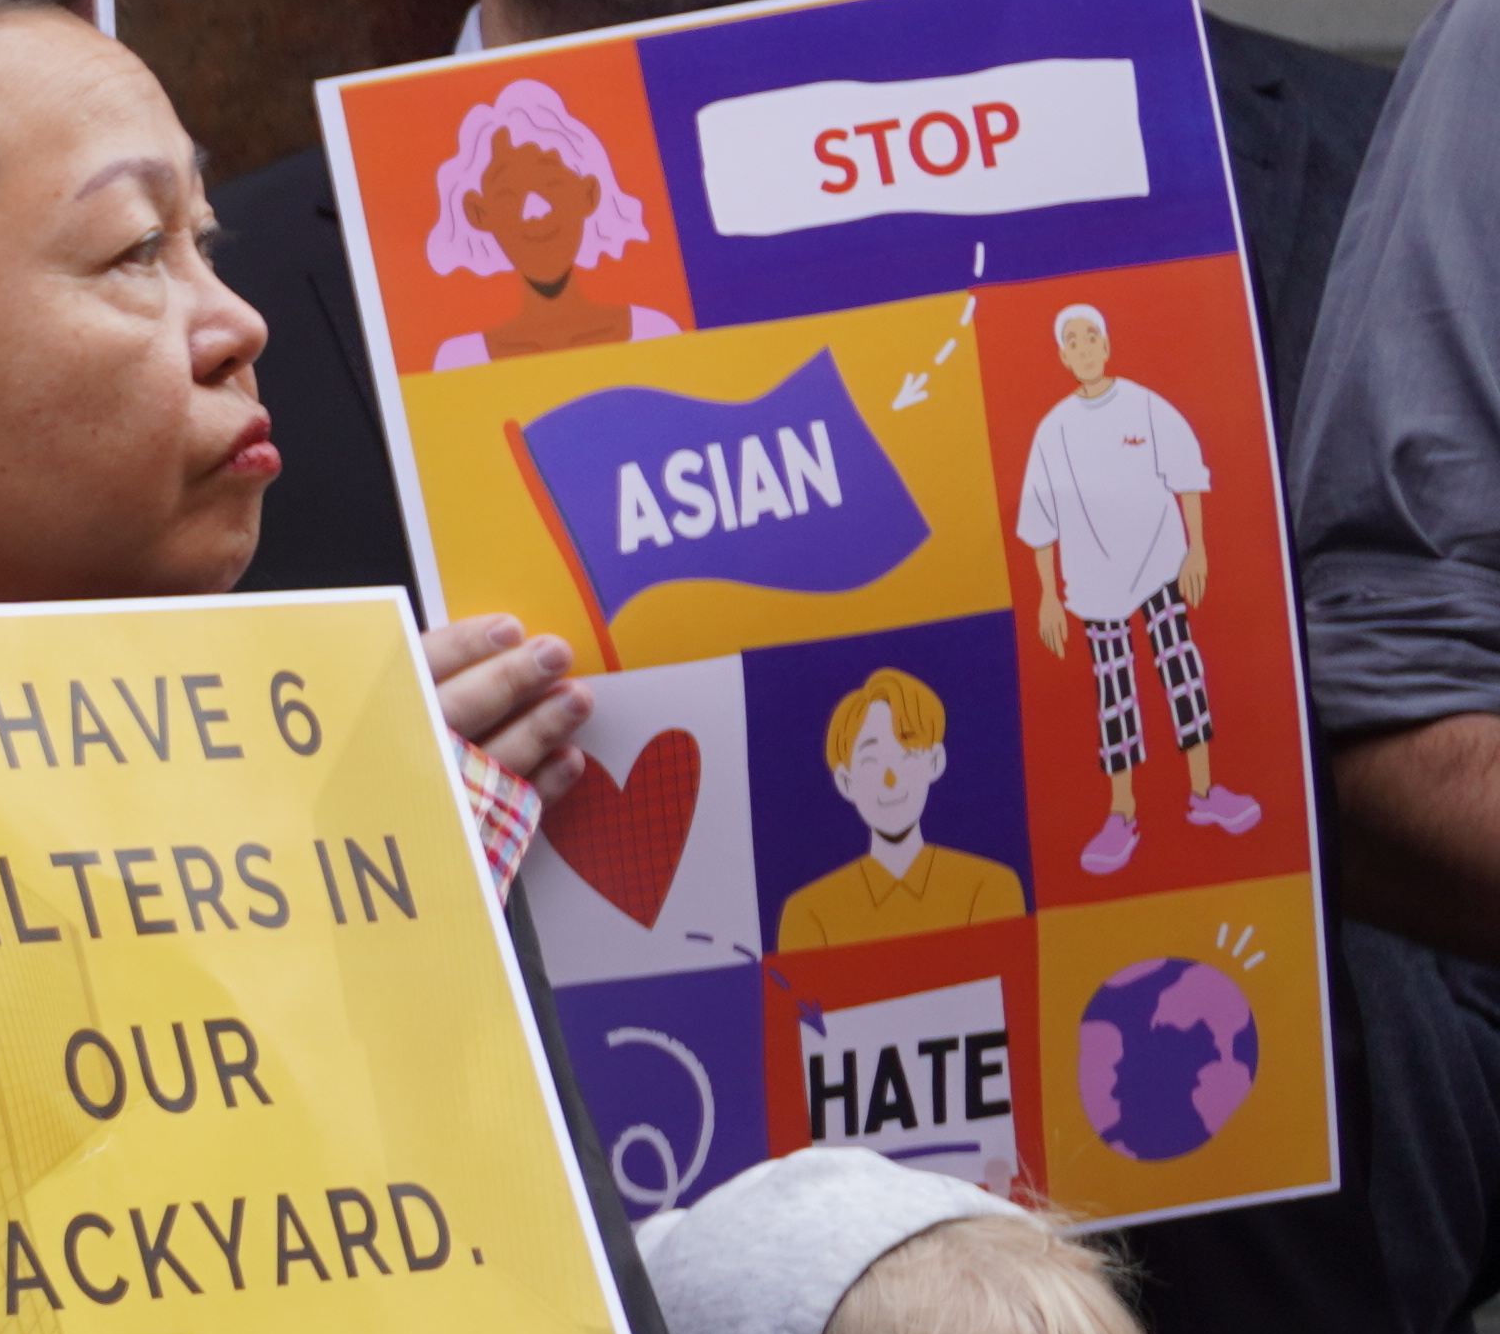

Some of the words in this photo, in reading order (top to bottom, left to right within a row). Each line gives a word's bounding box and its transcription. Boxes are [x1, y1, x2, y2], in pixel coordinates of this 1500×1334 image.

[813, 100, 1021, 197] STOP
[617, 421, 844, 555] ASIAN
[268, 670, 324, 759] 6
[315, 833, 420, 927] IN
[63, 1016, 274, 1122] OUR
[809, 1029, 1011, 1141] HATE
